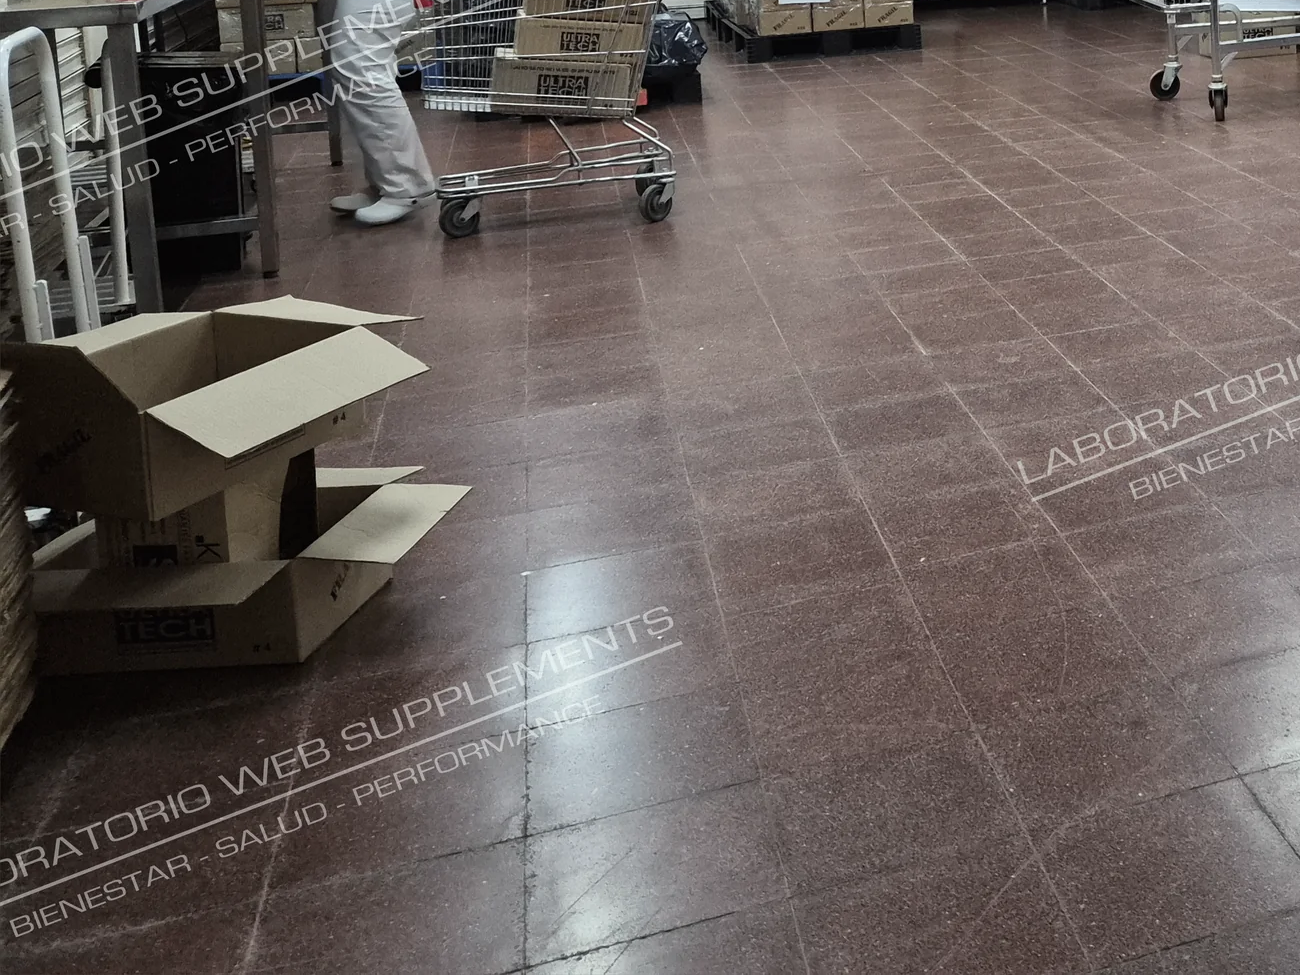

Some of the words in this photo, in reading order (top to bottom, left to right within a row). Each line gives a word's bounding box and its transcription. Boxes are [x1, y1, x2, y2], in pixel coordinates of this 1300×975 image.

[826, 9, 847, 27] FRAGIL
[877, 6, 898, 23] FRAGIL
[562, 32, 599, 42] ULTRA
[562, 41, 600, 51] TECH
[539, 76, 585, 87] ULTRA
[539, 85, 588, 96] TECH
[120, 618, 212, 640] TECH
